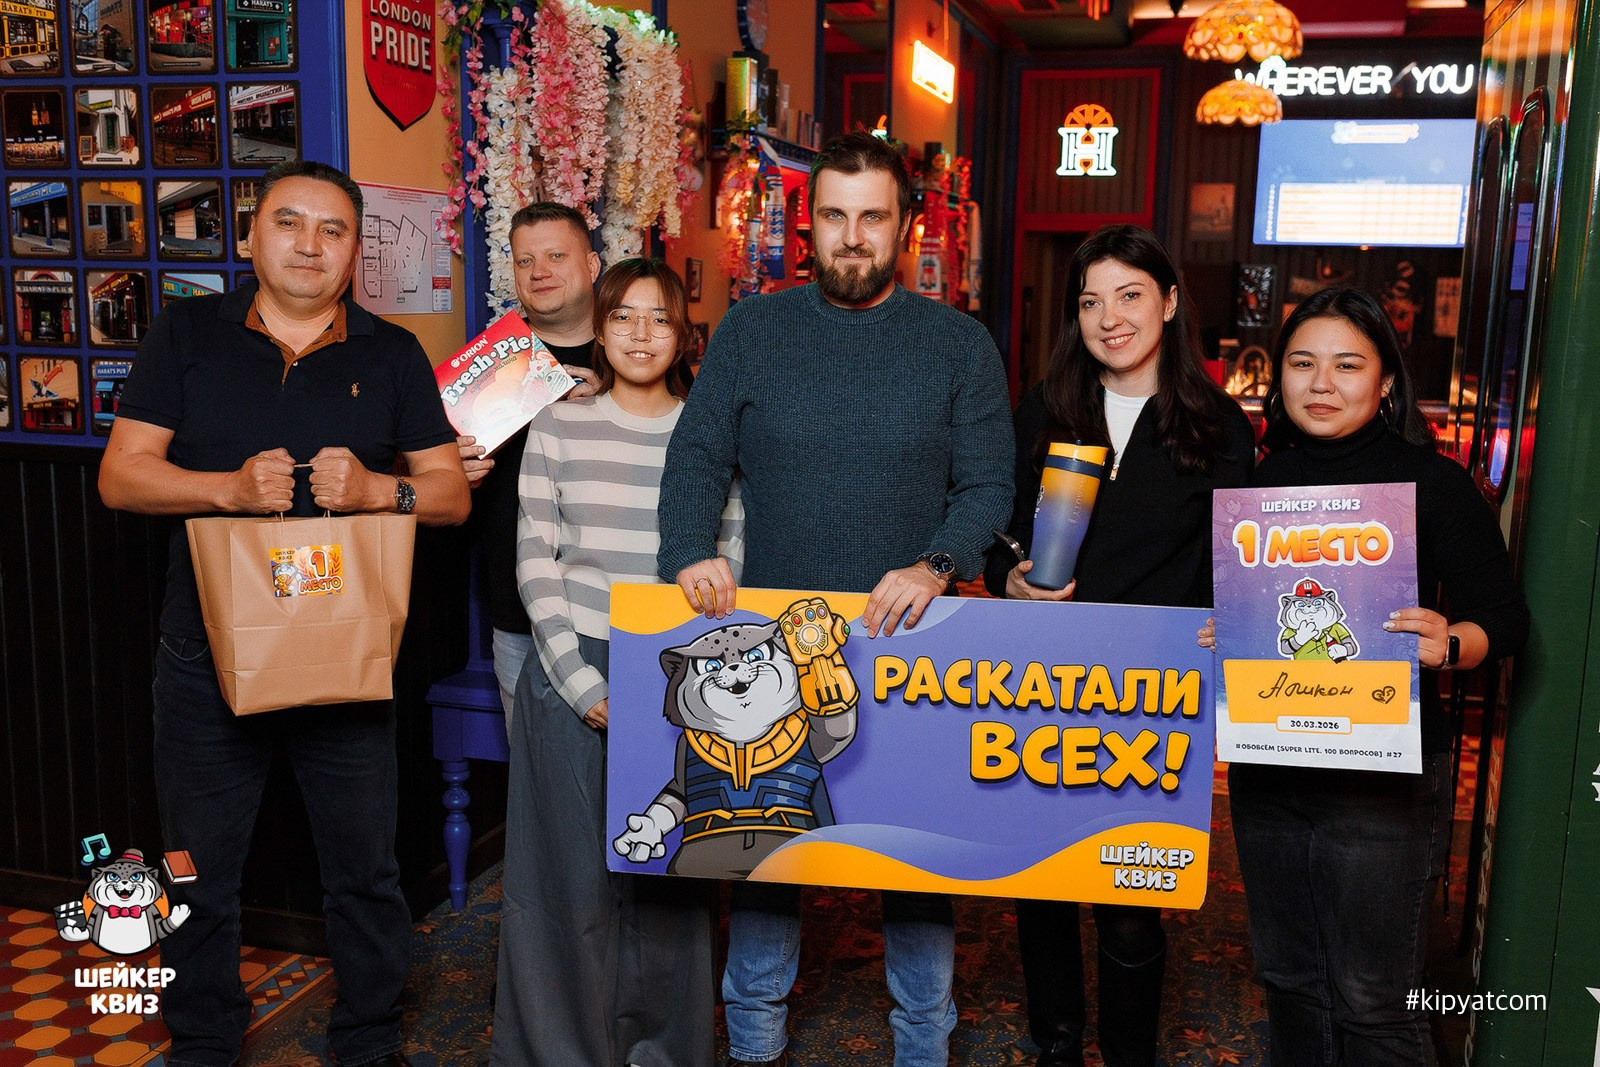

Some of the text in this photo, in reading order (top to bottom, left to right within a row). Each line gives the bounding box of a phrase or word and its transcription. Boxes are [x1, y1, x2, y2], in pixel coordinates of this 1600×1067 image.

[370, 0, 431, 31] LONDON
[370, 21, 432, 71] PRIDE
[1412, 63, 1475, 94] YOU
[459, 339, 489, 362] ORION
[1261, 498, 1361, 512] ШЕЙКЕР КВИЗ
[1267, 526, 1390, 564] МЕСТО
[300, 576, 342, 593] МЕСТО
[874, 655, 1200, 719] РАСКАТАЛИ
[1290, 720, 1340, 730] 30.03.2026
[970, 721, 1190, 794] ВСЕХ!
[1100, 842, 1195, 868] ШЕЙКЕР
[1114, 868, 1177, 891] КВИЗ
